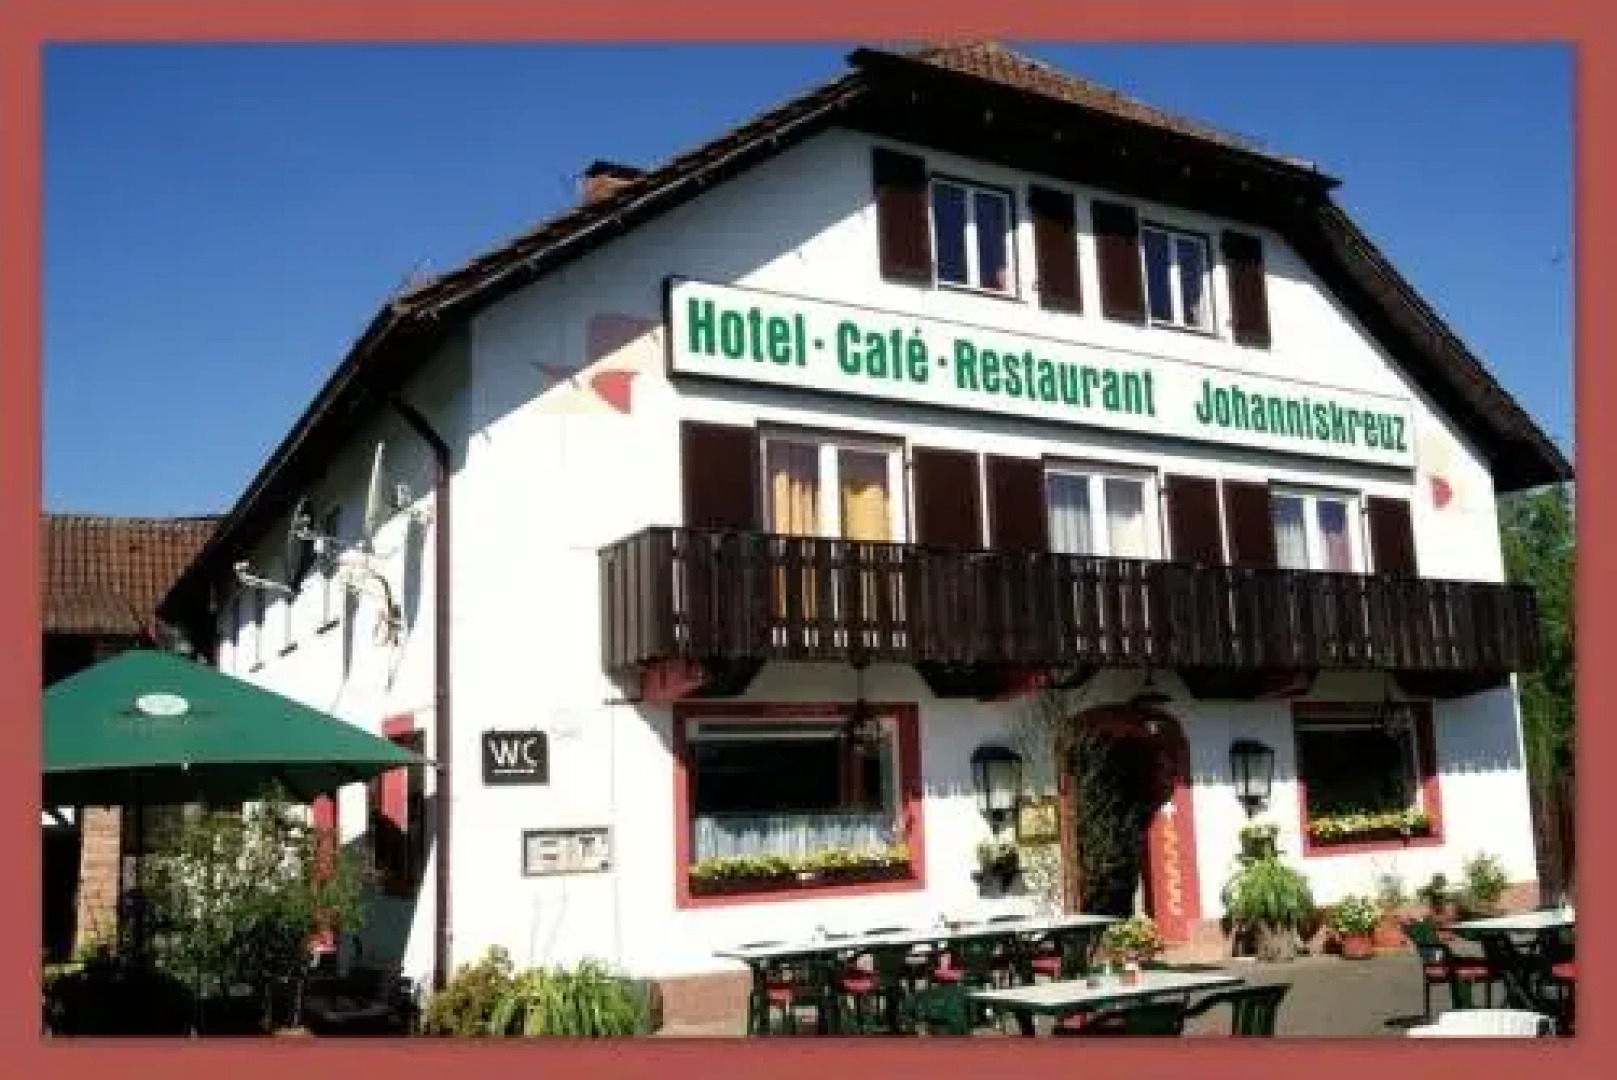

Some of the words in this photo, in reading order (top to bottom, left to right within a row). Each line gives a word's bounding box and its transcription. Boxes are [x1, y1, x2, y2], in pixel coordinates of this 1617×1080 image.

[687, 297, 807, 366] Hotel
[837, 320, 929, 384] Café
[953, 338, 1156, 417] Restaurant
[1195, 377, 1408, 453] Johanniskreuz
[488, 737, 538, 767] WC
